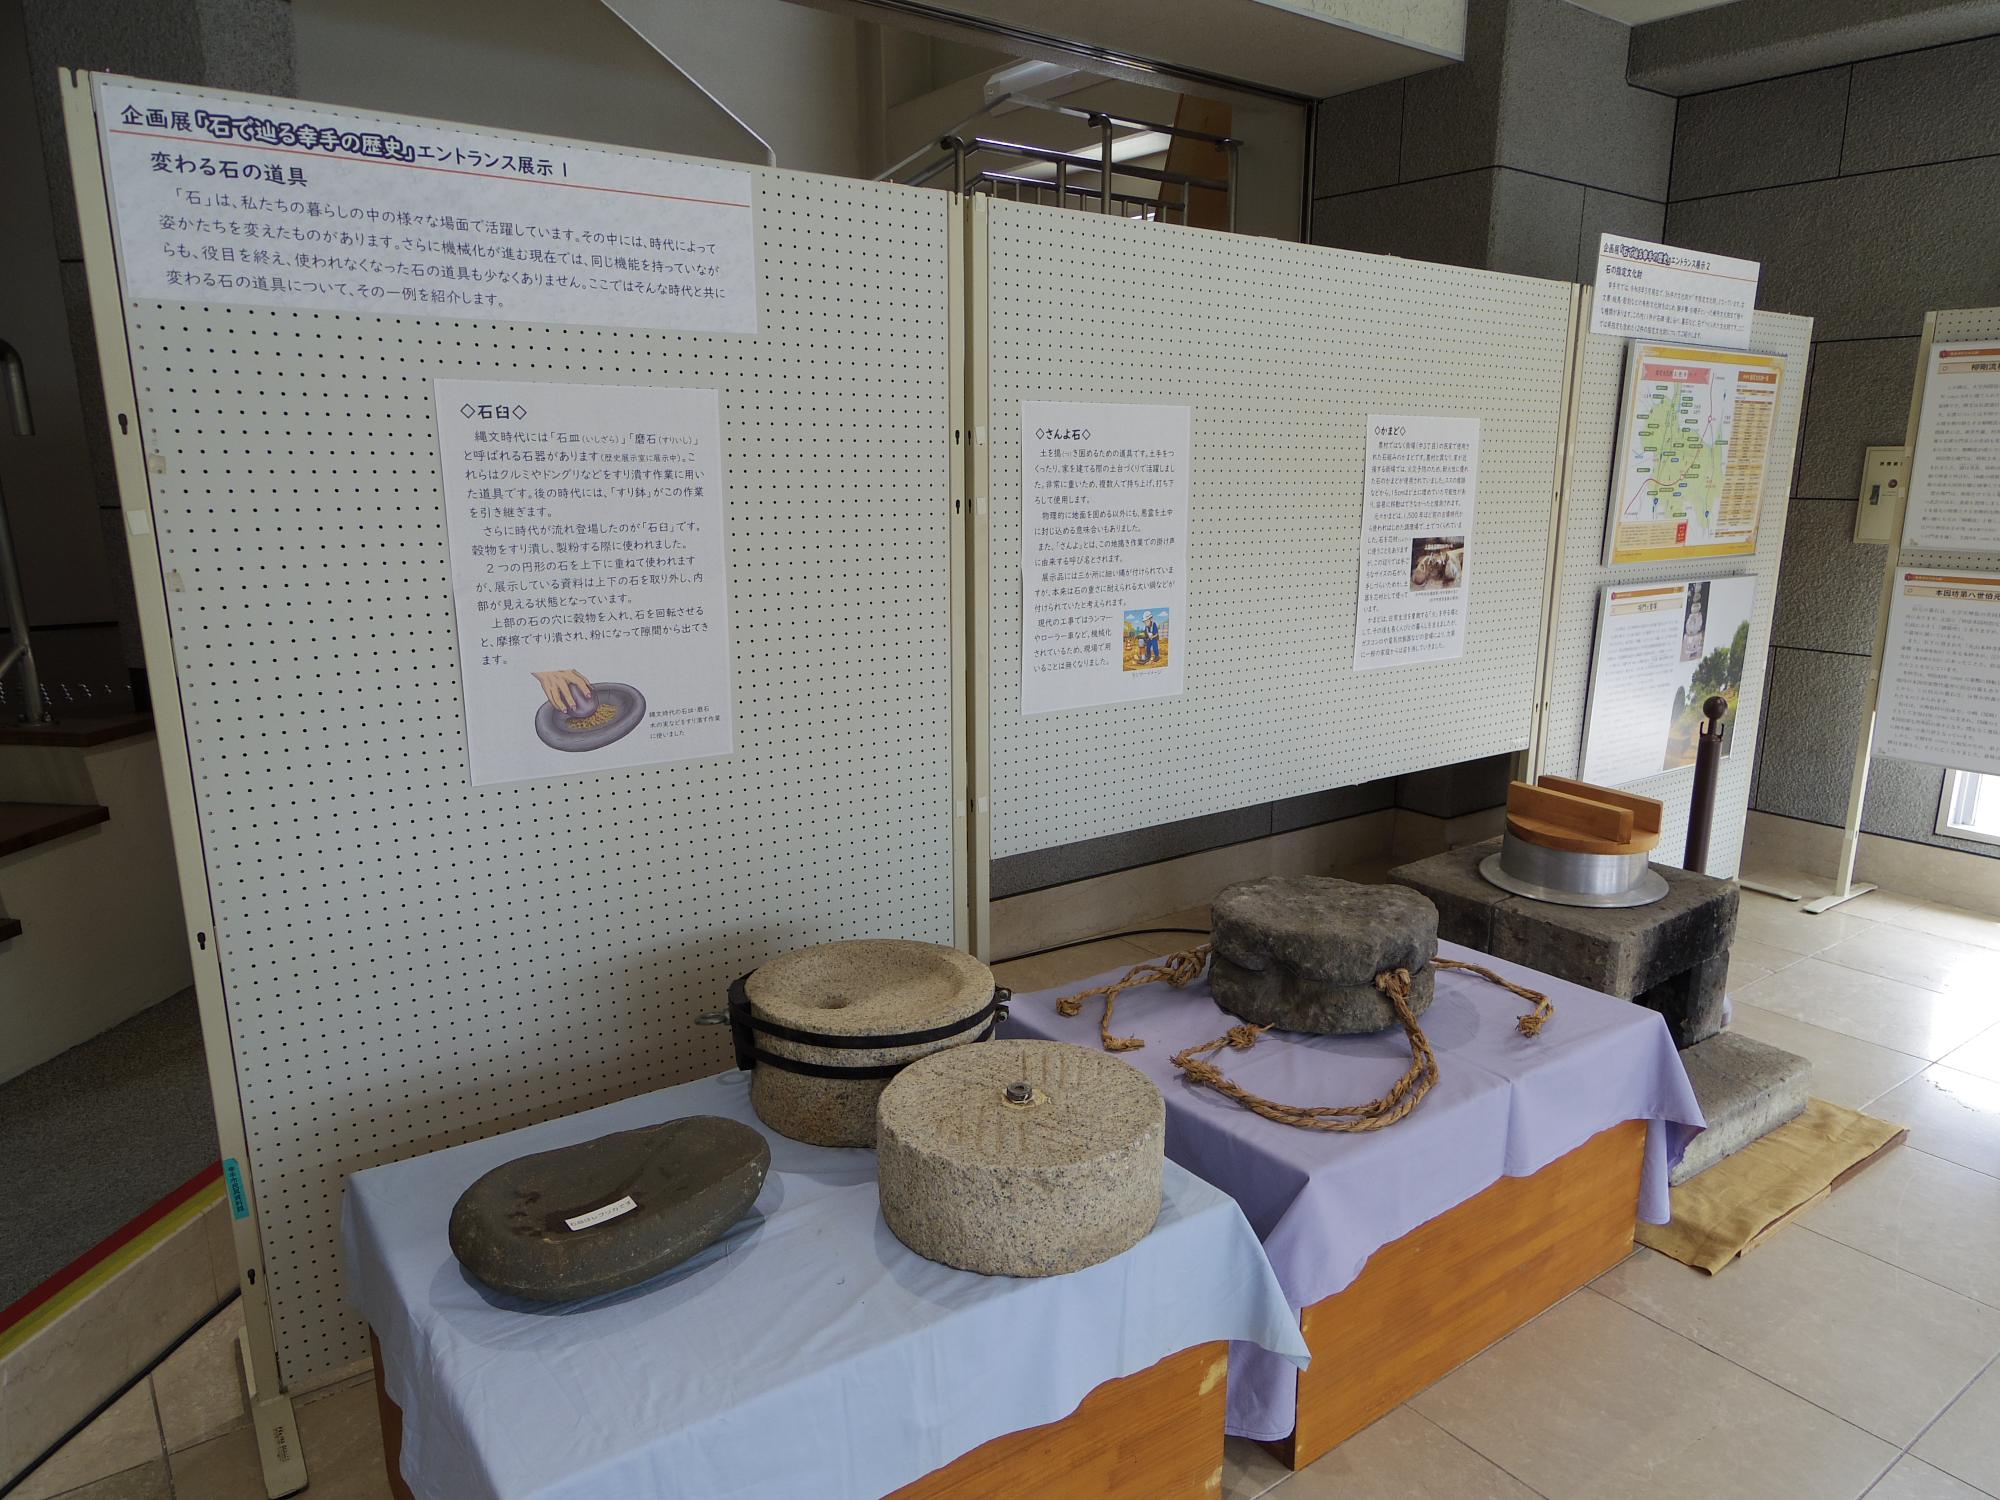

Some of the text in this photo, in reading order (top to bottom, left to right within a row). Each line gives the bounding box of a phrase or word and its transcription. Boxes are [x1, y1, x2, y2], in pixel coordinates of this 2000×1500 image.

[150, 151, 308, 187] 変わる石の道具
[166, 269, 504, 308] 変わる石の道具について、その一例を紹介します。
[465, 468, 705, 481] れらはクルミやドングリなどをすり潰す作業に用い
[467, 486, 705, 500] た道具です。後の時代には、「すり鉢」がこの作業
[1034, 495, 1091, 505] ろして使用します。
[469, 506, 552, 519] を引き継ぎます。
[483, 521, 701, 537] さらに時代が流れ登場したのが「石臼」です。
[1034, 524, 1141, 536] に封じ込める意味合いもありました。
[471, 540, 688, 557] 穀物をすり潰し、製粉する際に使われました。
[1034, 554, 1123, 567] に由来する呼び名とされます。
[476, 573, 704, 594] が、展示している資料は上下の石を取り外し、内
[477, 593, 633, 612] 部が見える状態となっています。
[1034, 598, 1128, 613] 付けられていたと考えられます。
[491, 606, 705, 630] 上部の石の穴に穀物を入れ、石を回転させる
[1038, 615, 1113, 628] 現代の工事ではランマー
[480, 622, 709, 648] と、摩擦ですり潰され、粉になって隙間から出てき
[1034, 628, 1112, 641] やローラー車など、機械化
[1034, 642, 1111, 657] されているため、現場で用
[481, 654, 508, 666] ます。
